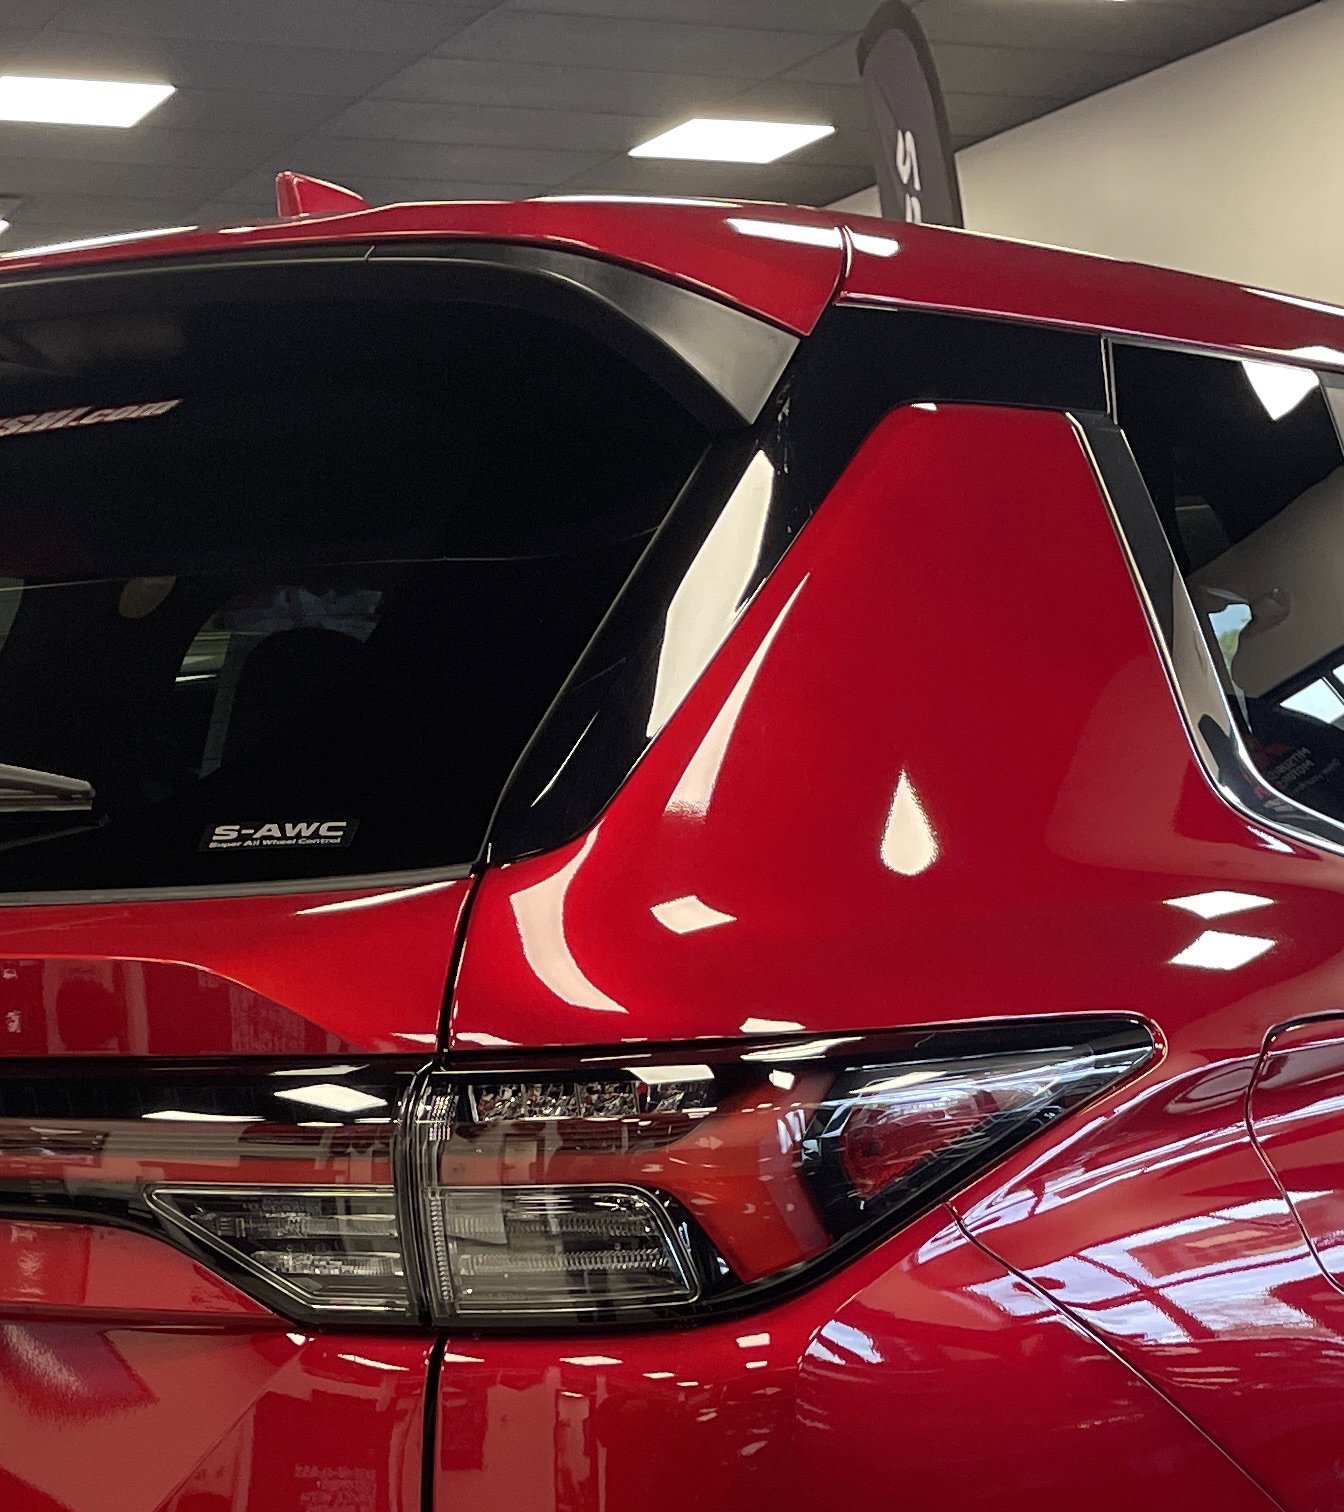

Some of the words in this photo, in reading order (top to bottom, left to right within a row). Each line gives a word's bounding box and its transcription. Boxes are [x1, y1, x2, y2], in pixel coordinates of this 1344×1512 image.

[211, 821, 347, 841] S-AWC
[208, 841, 243, 849] Super
[244, 839, 261, 847] All
[262, 838, 297, 846] Wheel
[298, 836, 342, 845] Control
